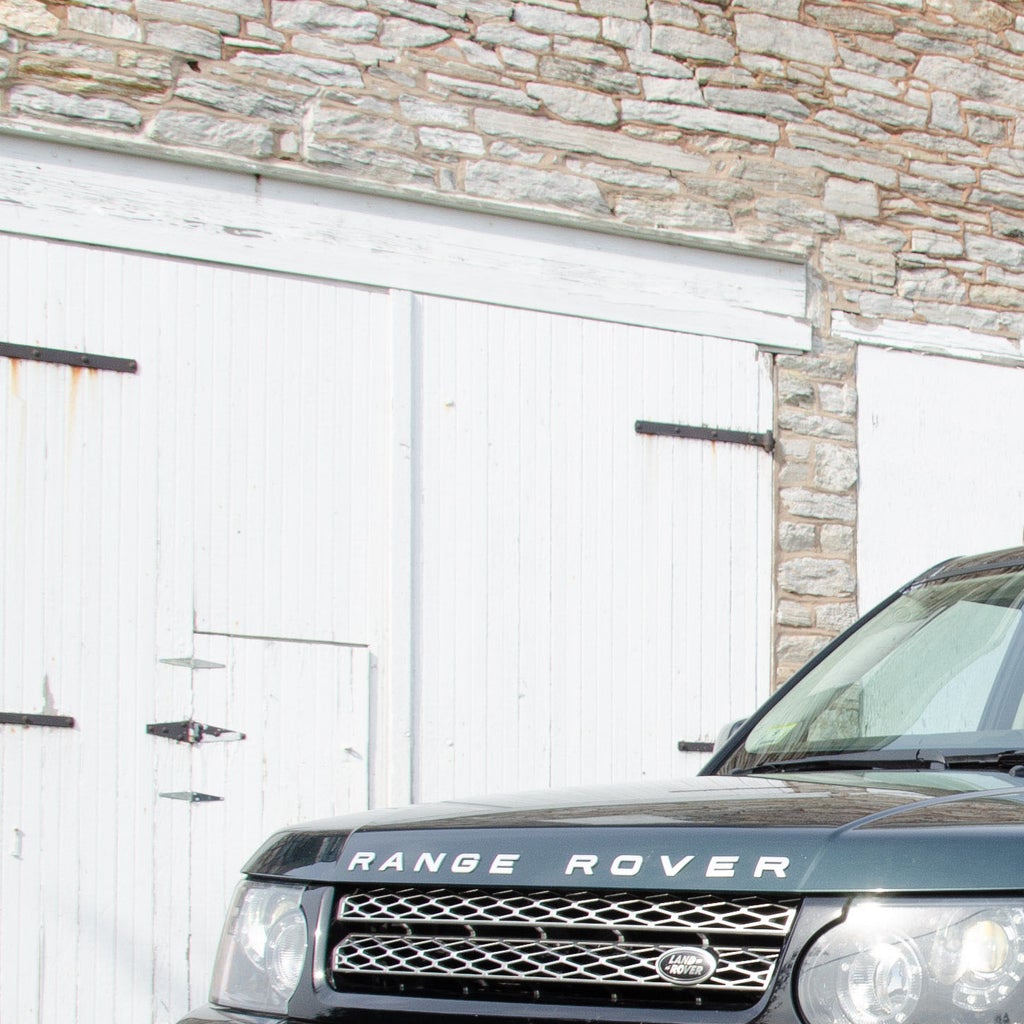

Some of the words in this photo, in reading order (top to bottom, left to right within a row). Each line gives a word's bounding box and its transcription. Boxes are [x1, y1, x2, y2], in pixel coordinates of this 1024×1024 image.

[348, 852, 520, 875] RANGE
[565, 854, 790, 879] ROVER
[668, 954, 697, 965] LAND
[669, 964, 703, 975] ROVER
